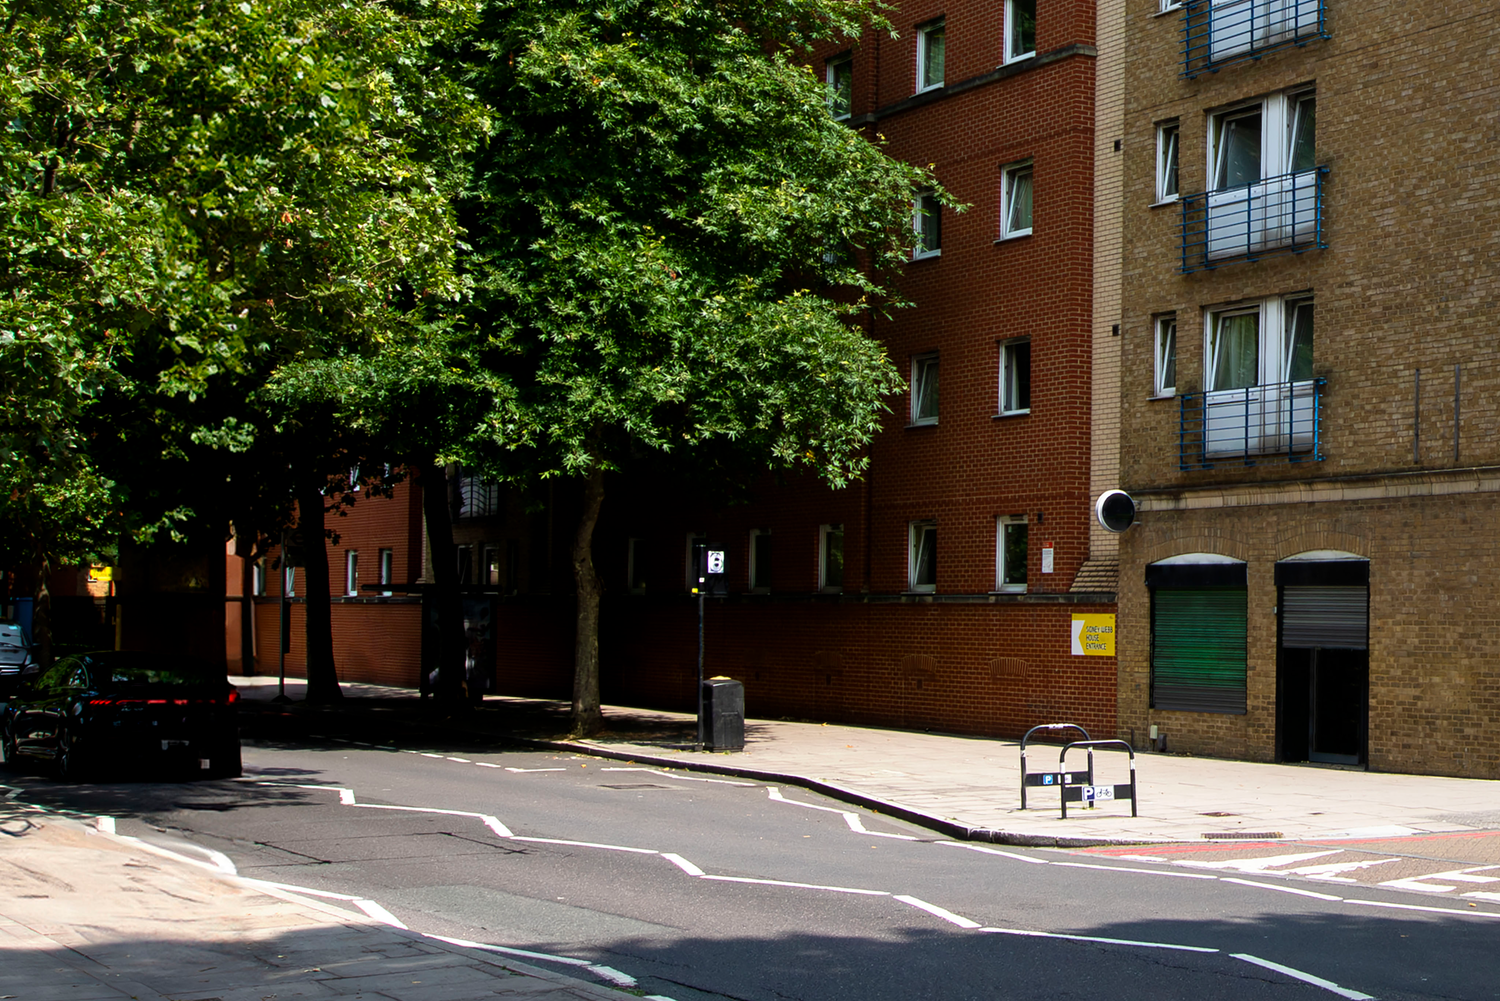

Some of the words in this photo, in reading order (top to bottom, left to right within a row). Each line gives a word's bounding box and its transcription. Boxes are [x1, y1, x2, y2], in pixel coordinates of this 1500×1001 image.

[1086, 642, 1106, 650] ENTRANCE
[1045, 776, 1052, 784] P
[1084, 787, 1094, 800] P
